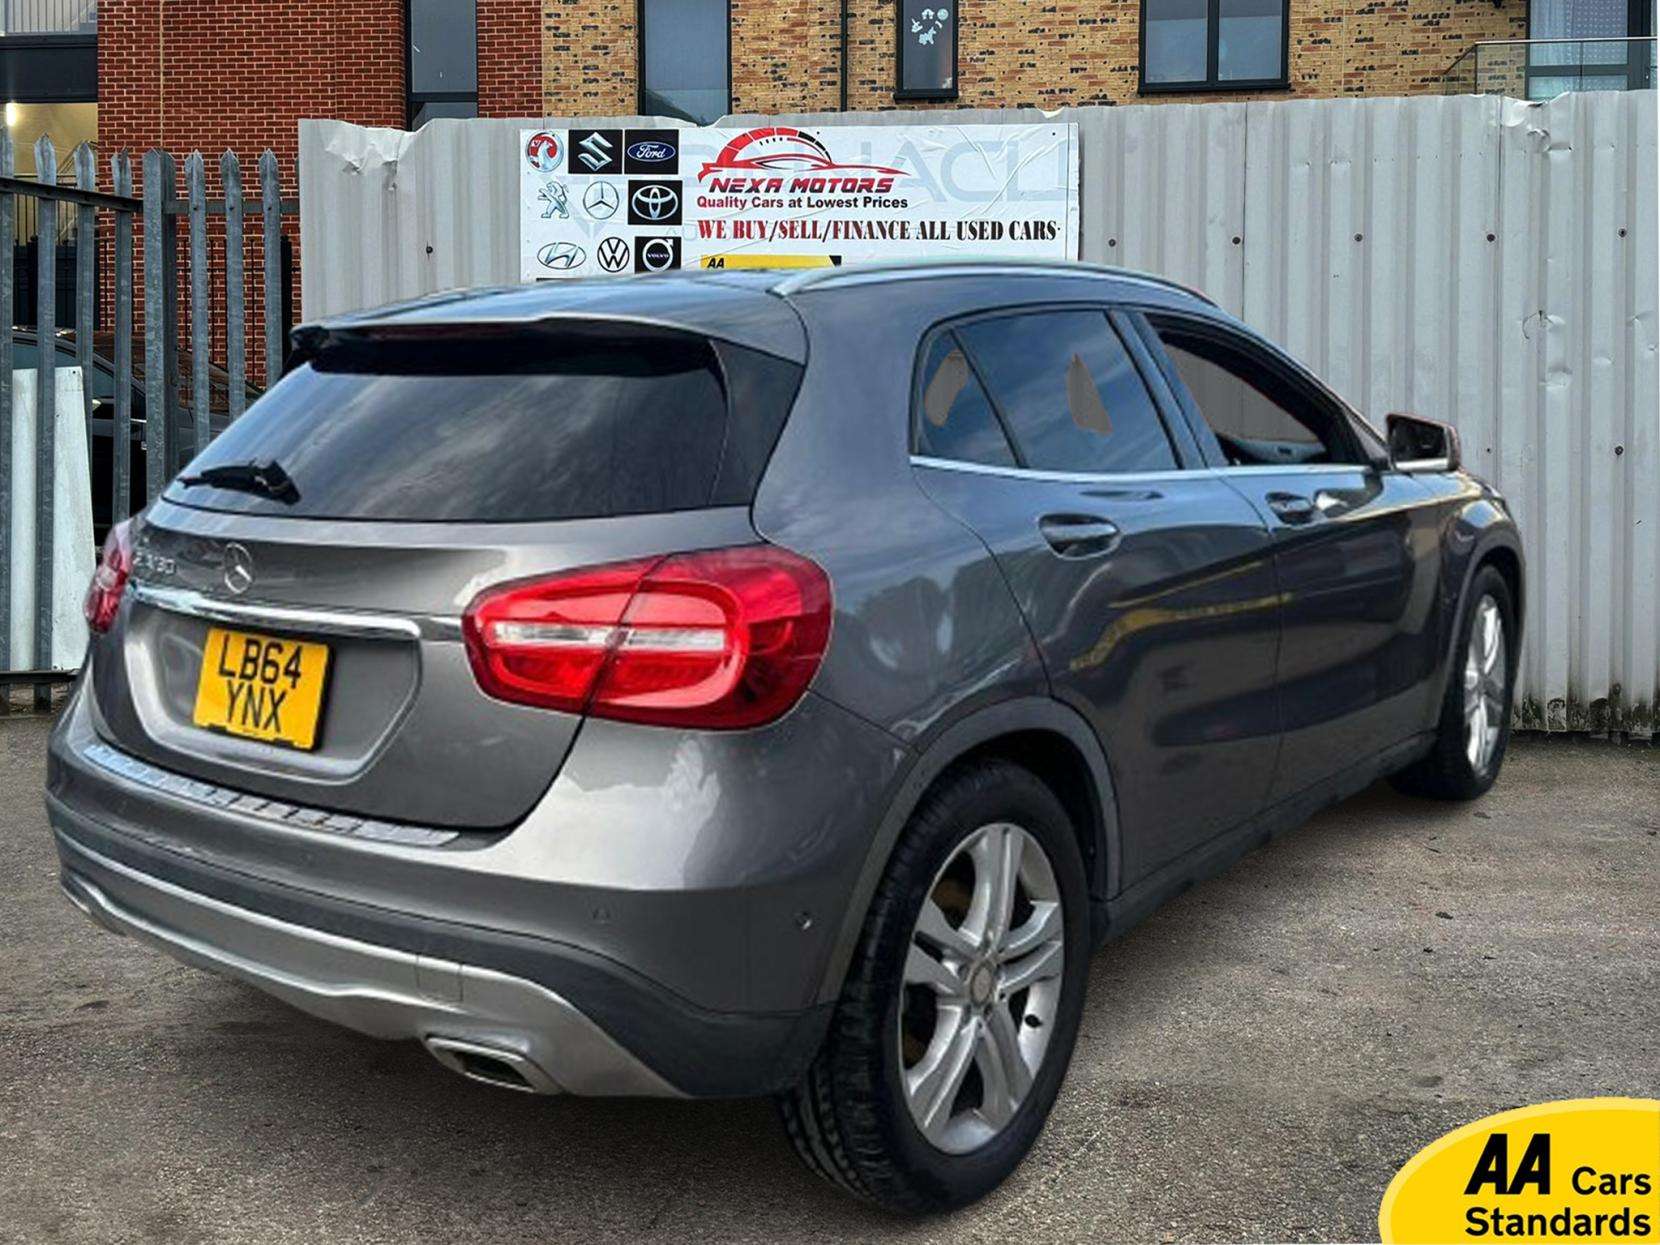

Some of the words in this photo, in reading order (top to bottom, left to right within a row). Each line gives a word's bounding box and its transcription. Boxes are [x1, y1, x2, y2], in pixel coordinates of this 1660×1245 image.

[636, 144, 666, 158] Ford
[709, 178, 784, 193] NEXA
[789, 178, 895, 193] MOTORS
[697, 196, 747, 210] Quality
[752, 196, 783, 208] Cars
[788, 197, 803, 208] at
[807, 196, 858, 208] Lowest
[863, 196, 908, 208] Prices
[697, 220, 726, 239] WE
[733, 220, 910, 243] BUY/SELL/FINANCE
[916, 220, 950, 240] ALL
[957, 220, 1004, 240] USED
[1008, 220, 1057, 240] CARS
[707, 257, 725, 269] AA
[218, 635, 301, 689] LB64
[226, 679, 286, 732] YNX
